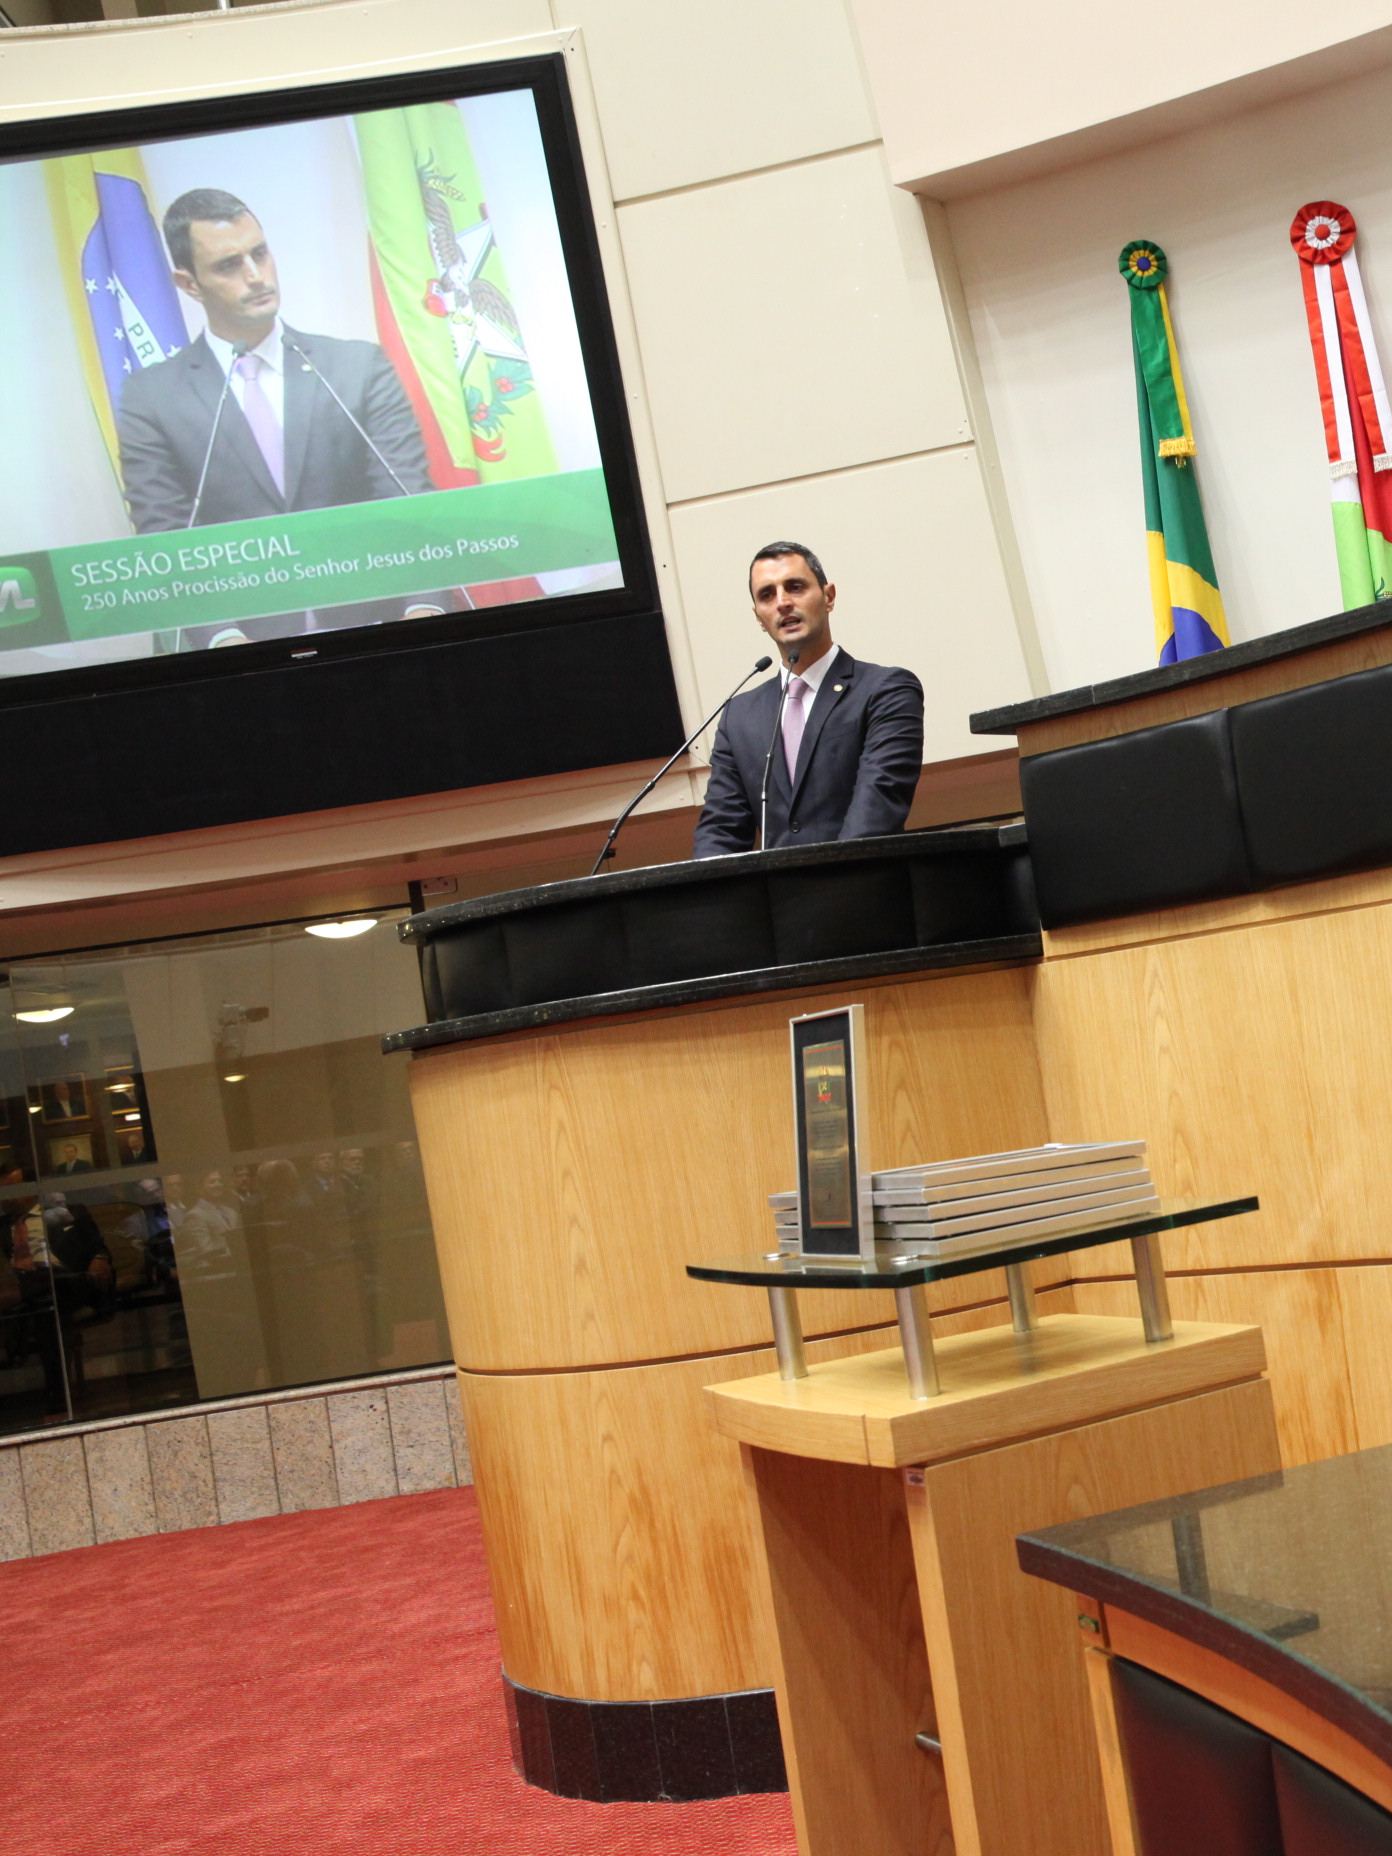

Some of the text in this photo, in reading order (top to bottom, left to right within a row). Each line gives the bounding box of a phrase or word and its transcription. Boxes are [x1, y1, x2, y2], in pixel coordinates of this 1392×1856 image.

[71, 534, 301, 588] SESSÃO ESPECIAL
[82, 534, 519, 611] 250 Anos Procissão do Senhor Jesus dos Passos
